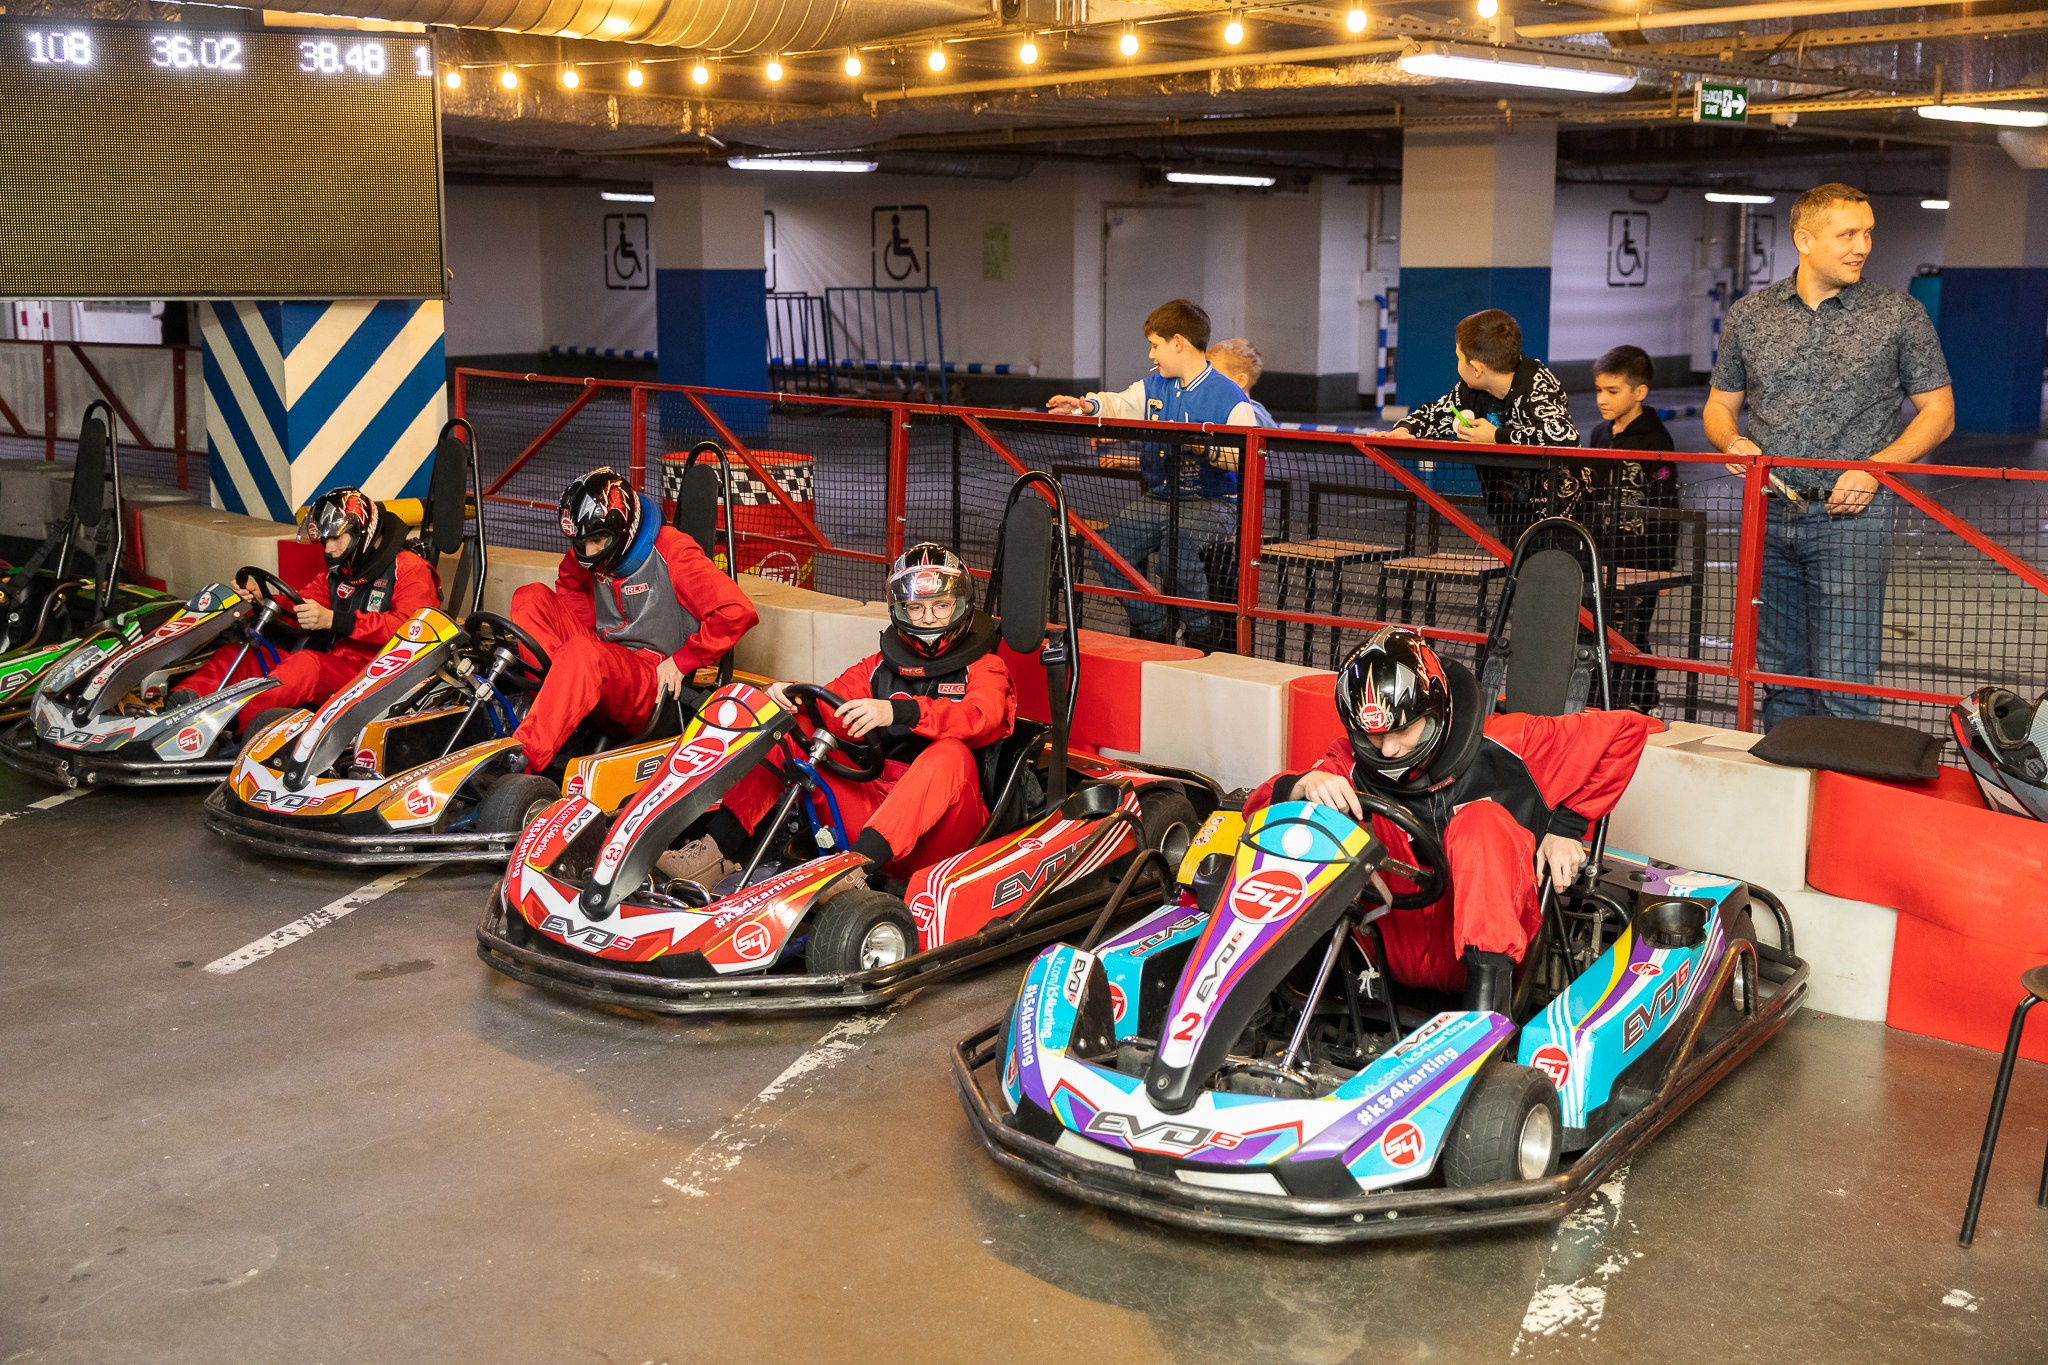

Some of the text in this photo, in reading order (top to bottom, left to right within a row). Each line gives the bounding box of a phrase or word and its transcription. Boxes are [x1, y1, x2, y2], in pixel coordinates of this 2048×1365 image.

[29, 31, 92, 64] 108
[151, 35, 242, 69] 36.02
[299, 41, 384, 75] 38.48
[627, 585, 647, 593] RLG
[409, 626, 420, 636] 39
[942, 685, 965, 693] RLG
[388, 752, 468, 792] #k54karting
[512, 817, 549, 878] #k54karting
[605, 848, 621, 860] 33
[714, 873, 807, 928] #k54karting
[912, 905, 934, 928] 54
[1235, 880, 1294, 919] 54
[738, 934, 765, 955] 54
[1039, 956, 1067, 1038] vk.com/k54karting
[1622, 958, 1691, 1054] EVO6
[1022, 984, 1039, 1068] #k54karting
[1173, 1012, 1202, 1041] 2
[1361, 1019, 1472, 1096] vk.com/k54karting
[1357, 1047, 1459, 1126] #k54karting
[1085, 1111, 1246, 1151] EVO6
[1385, 1132, 1420, 1160] 54
